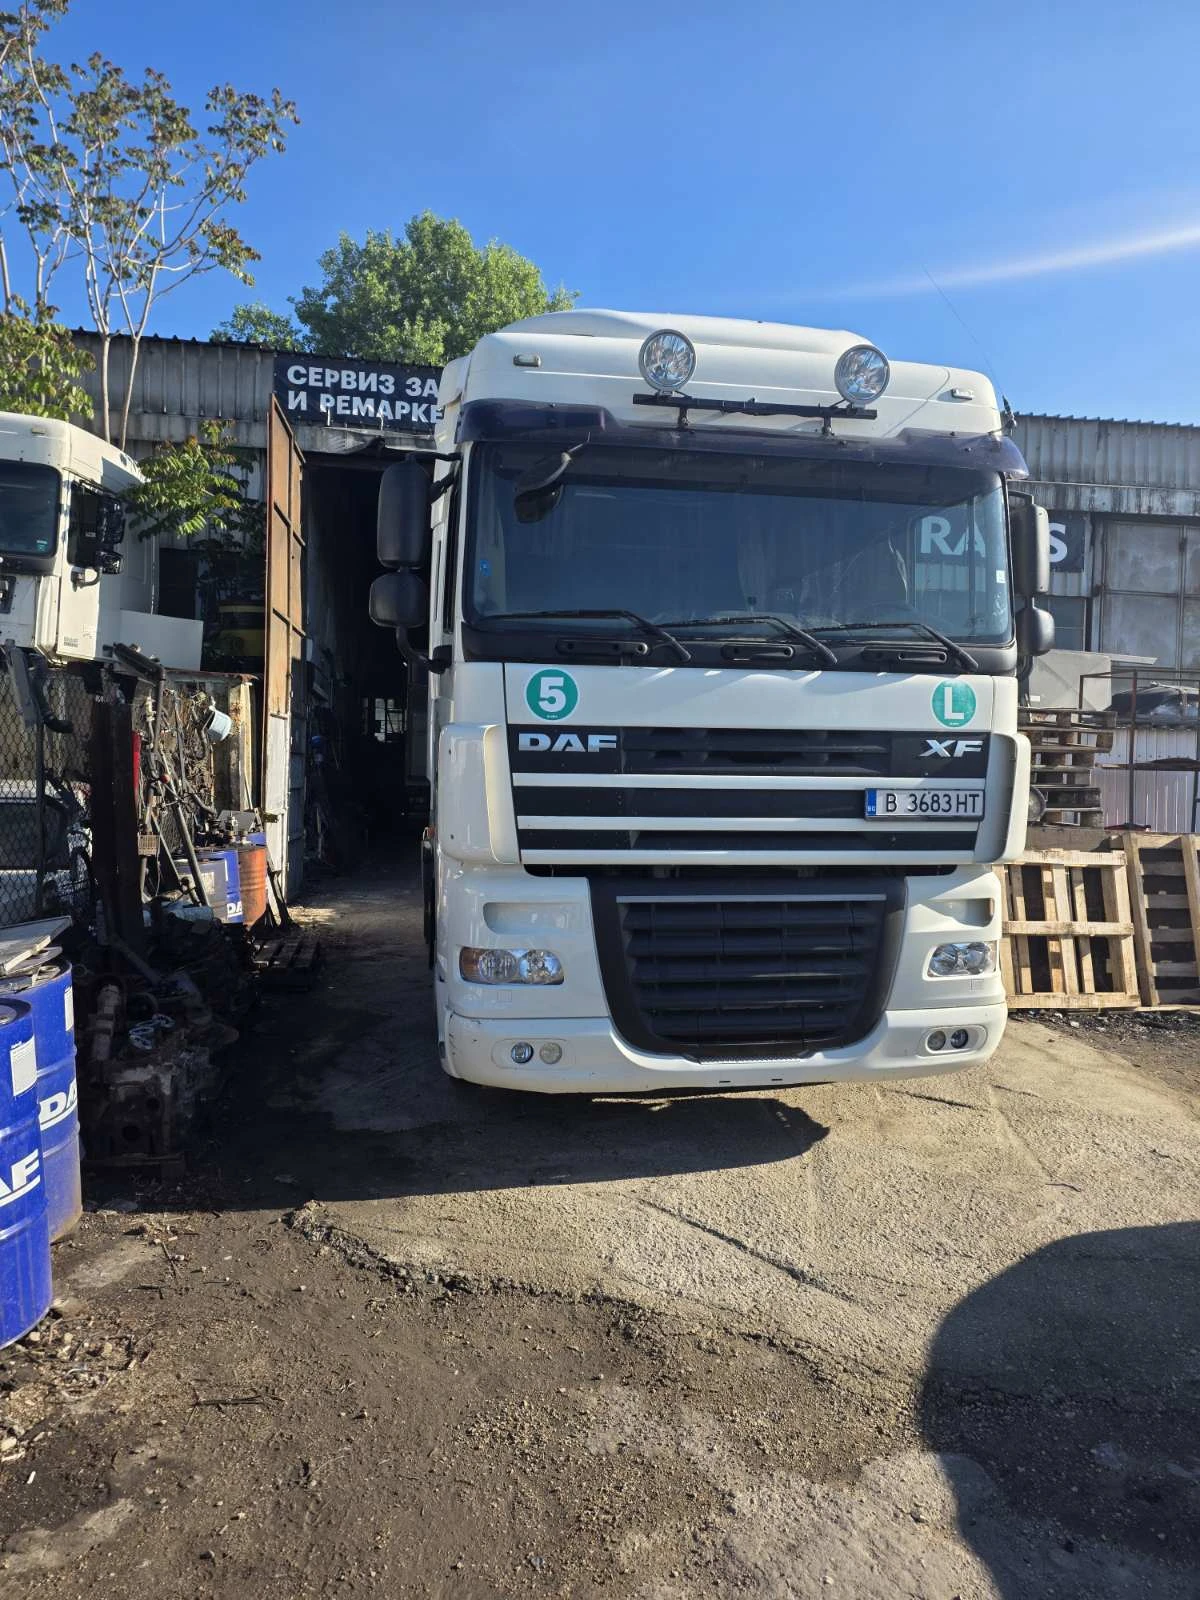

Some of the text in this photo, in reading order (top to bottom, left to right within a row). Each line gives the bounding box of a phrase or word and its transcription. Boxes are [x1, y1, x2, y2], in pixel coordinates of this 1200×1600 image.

[287, 365, 439, 398] СЕРВИЗ ЗА
[288, 391, 307, 411] И
[538, 676, 566, 713] 5
[944, 687, 965, 720] L
[518, 733, 617, 752] DAF
[919, 740, 983, 757] XF
